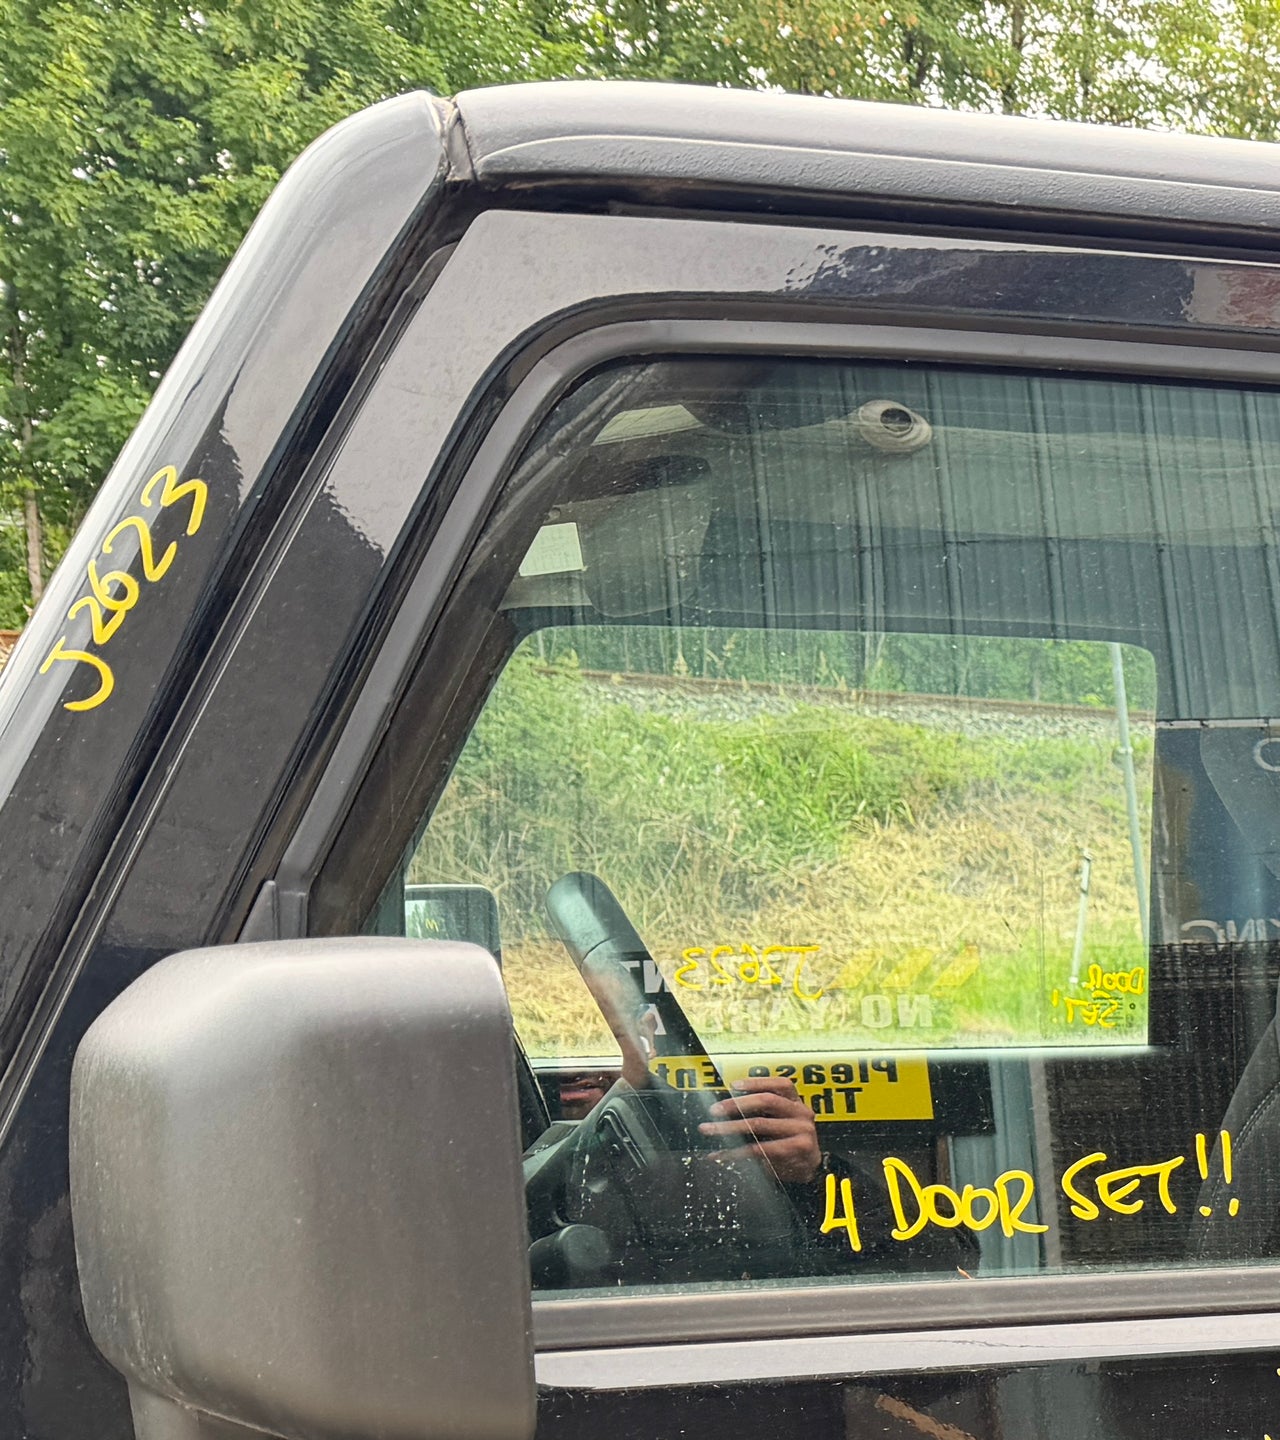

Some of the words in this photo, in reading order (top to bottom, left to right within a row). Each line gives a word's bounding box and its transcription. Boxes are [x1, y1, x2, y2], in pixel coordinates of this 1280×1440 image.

[39, 464, 209, 712] J2623
[820, 1172, 863, 1254] 4
[882, 1155, 1050, 1242] DOOR
[1060, 1128, 1241, 1222] SET!!
